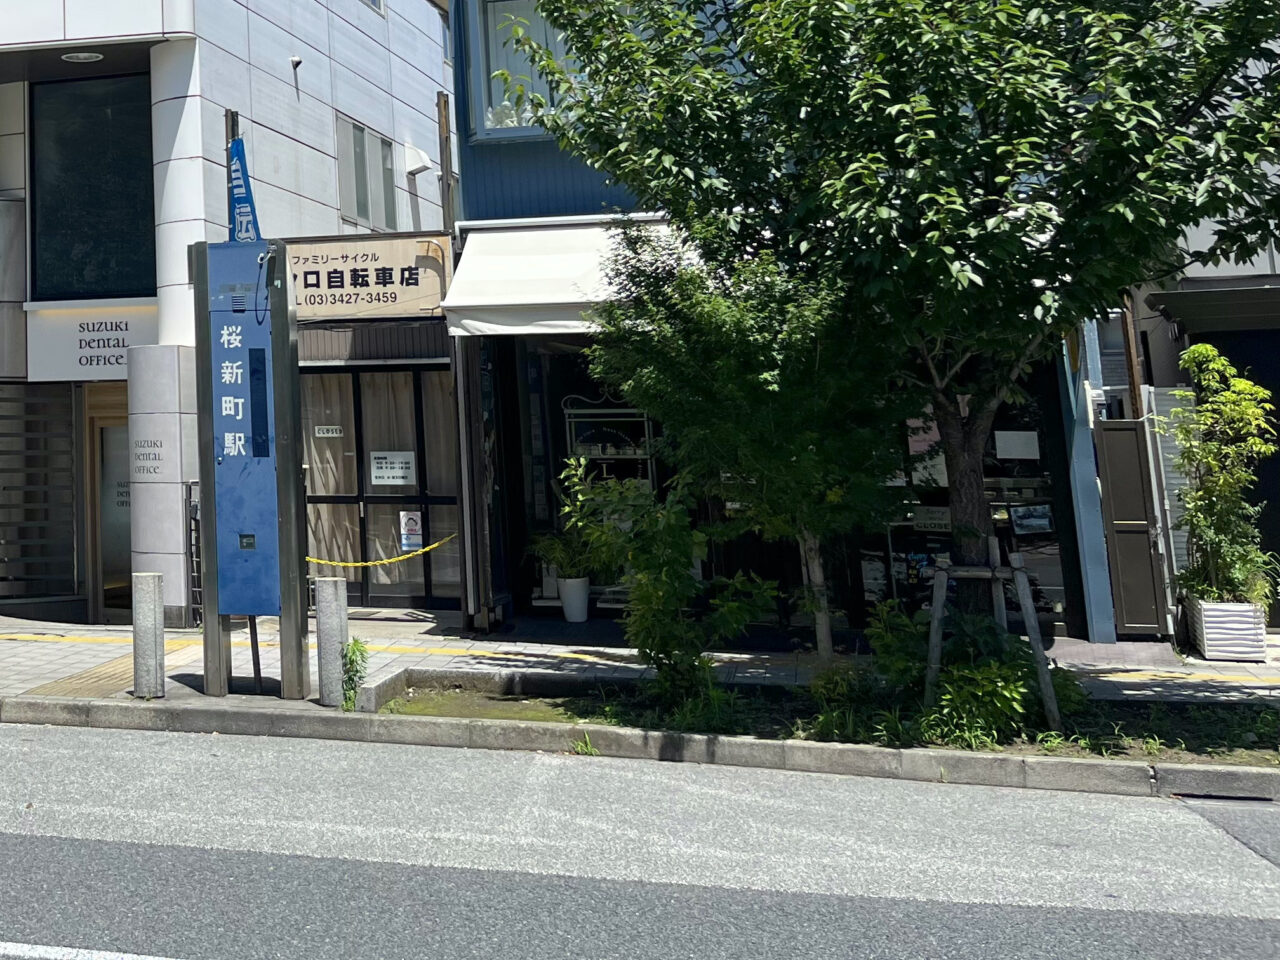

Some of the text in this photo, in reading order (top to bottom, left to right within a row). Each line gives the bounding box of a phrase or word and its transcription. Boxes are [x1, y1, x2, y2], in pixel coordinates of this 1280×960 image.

[292, 253, 380, 265] ファミリーサイクル
[293, 266, 420, 290] 口自転車店
[220, 325, 246, 457] 桜新町駅
